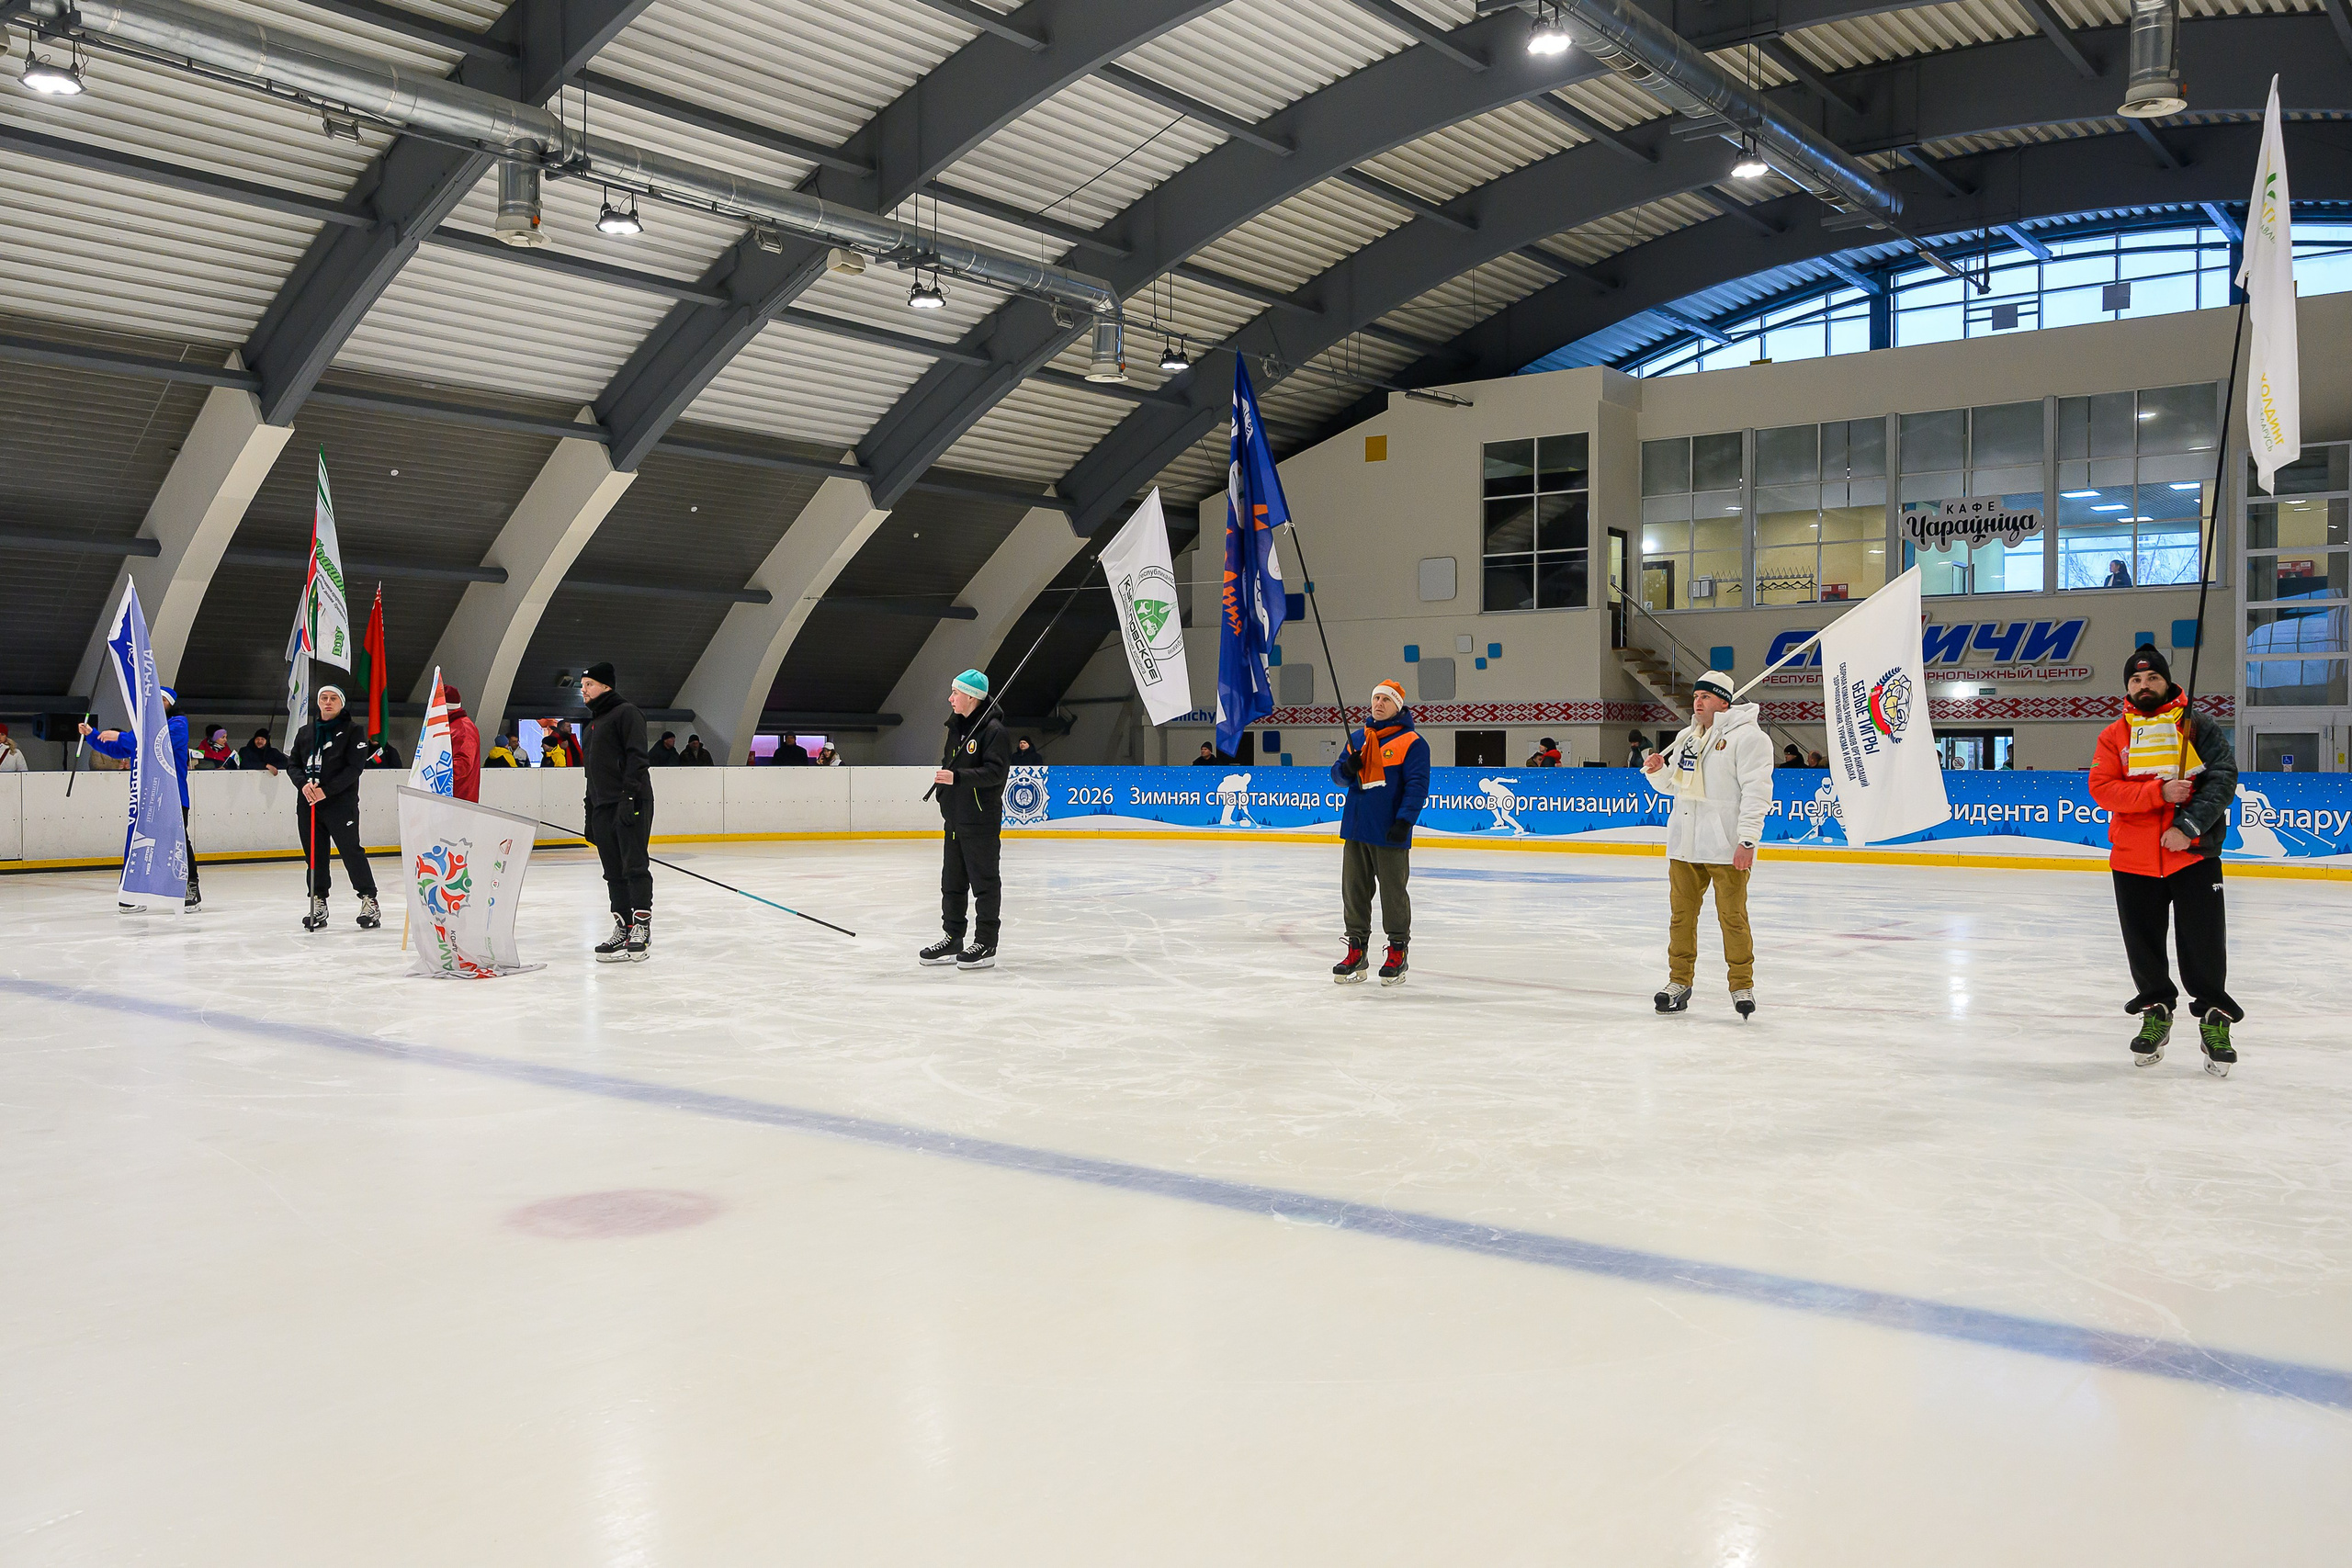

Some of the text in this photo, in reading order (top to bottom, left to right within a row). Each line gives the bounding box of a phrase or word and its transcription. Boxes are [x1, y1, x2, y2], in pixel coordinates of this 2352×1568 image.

[1946, 501, 1996, 514] КАФЕ
[1905, 513, 2038, 547] Чараўніца
[2036, 666, 2088, 680] ЦЕНТР
[1841, 686, 1849, 712] КОМАНДА
[1851, 680, 1870, 717] БЕЛЫЕ
[1844, 711, 1857, 746] РАБОТНИКОВ
[1858, 716, 1880, 755] ТИГРЫ
[1837, 727, 1847, 751] ТУРИЗМА
[1843, 756, 1857, 781] ОТДЫХА
[1851, 746, 1871, 788] ОРГАНИЗАЦИЙ
[1067, 786, 1114, 806] 2026
[1129, 786, 1201, 807] Зимняя
[1204, 790, 1320, 810] спартакиада
[1501, 793, 1639, 817] организаций
[2240, 801, 2352, 837] Белару
